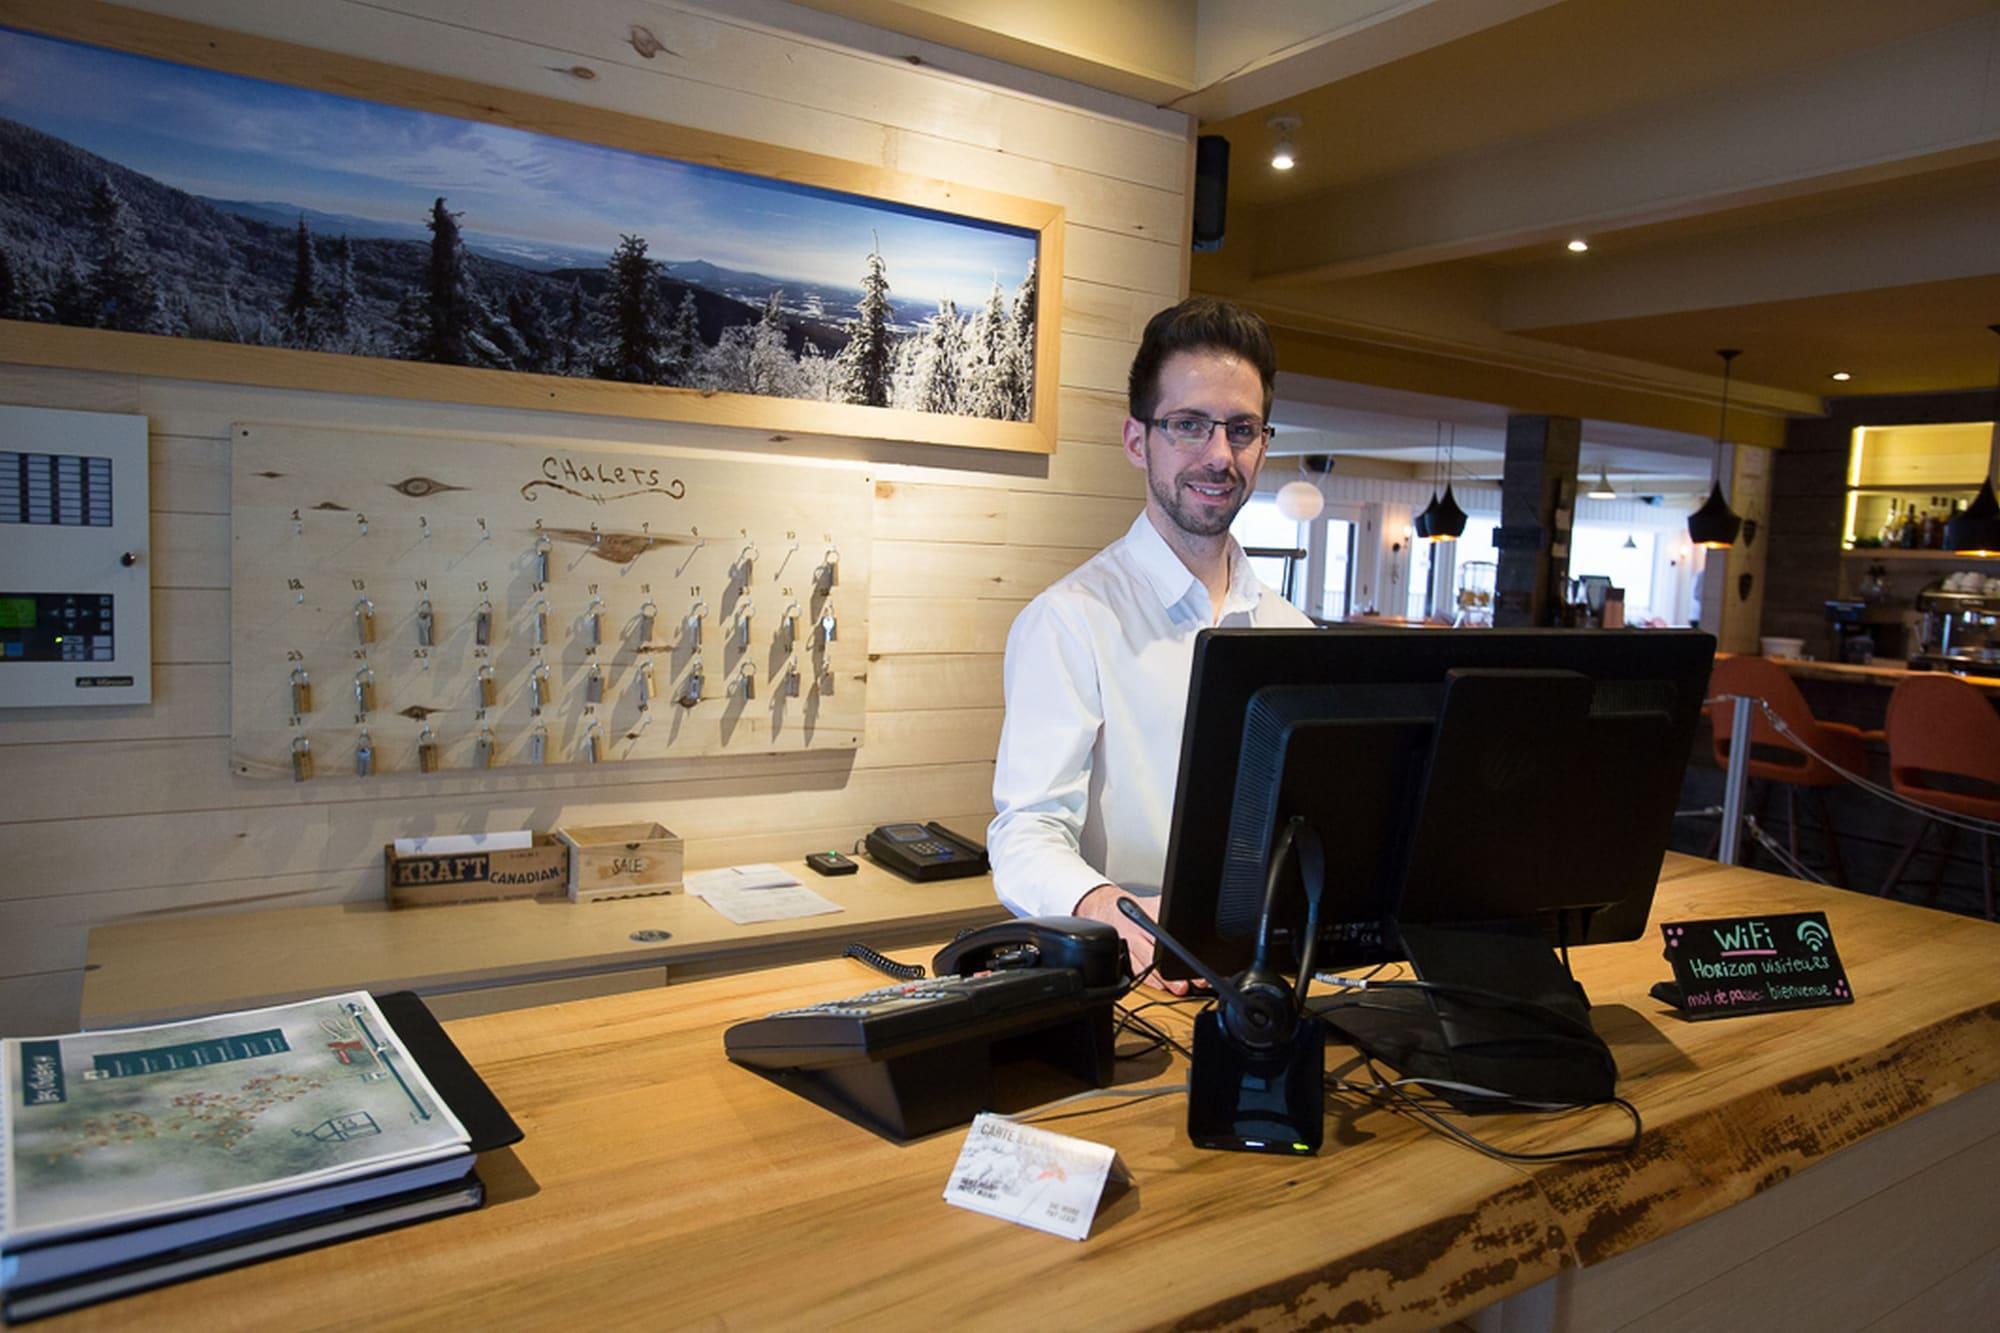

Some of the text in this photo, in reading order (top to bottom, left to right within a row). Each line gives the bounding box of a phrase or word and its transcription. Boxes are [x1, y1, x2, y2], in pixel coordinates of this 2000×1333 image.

[290, 508, 302, 521] 1
[356, 513, 368, 524] 2
[419, 515, 427, 528] 3
[476, 517, 486, 530] 4
[535, 517, 543, 530] 5
[287, 578, 304, 591] 12
[351, 579, 365, 591] 13
[415, 579, 428, 591] 14
[477, 580, 489, 592] 15
[532, 582, 545, 593] 16
[690, 586, 701, 597] 19
[287, 649, 304, 661] 23
[352, 648, 367, 660] 24
[413, 648, 428, 659] 25
[400, 857, 487, 884] KRAFT
[611, 857, 643, 875] SALE
[489, 865, 561, 886] CANADIAN
[1713, 920, 1776, 951] WiFi
